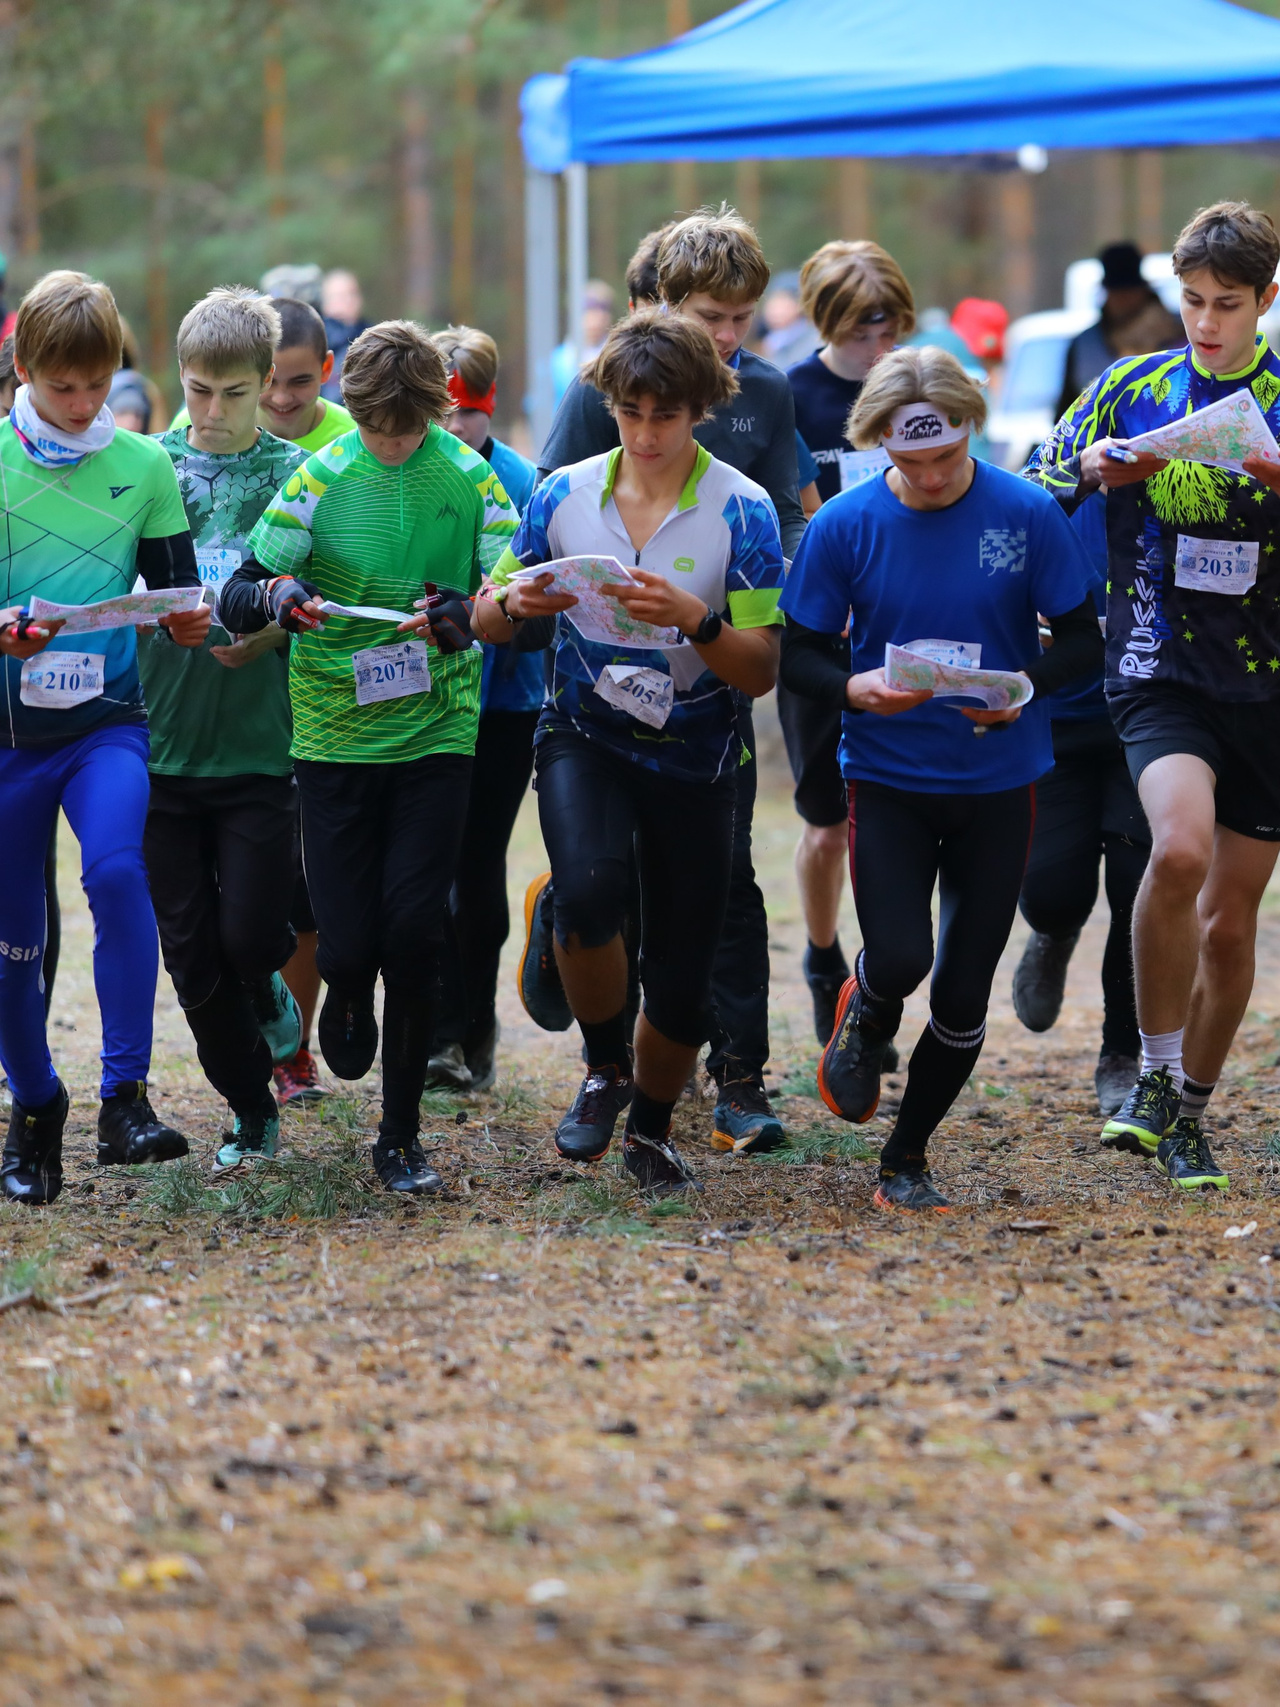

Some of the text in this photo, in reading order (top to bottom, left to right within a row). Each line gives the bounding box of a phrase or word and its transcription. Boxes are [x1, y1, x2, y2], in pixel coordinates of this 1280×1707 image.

[198, 564, 219, 581] 08
[1198, 557, 1233, 577] 203
[45, 671, 80, 691] 210
[373, 661, 405, 683] 207
[620, 677, 656, 704] 205
[0, 941, 39, 961] SSIA
